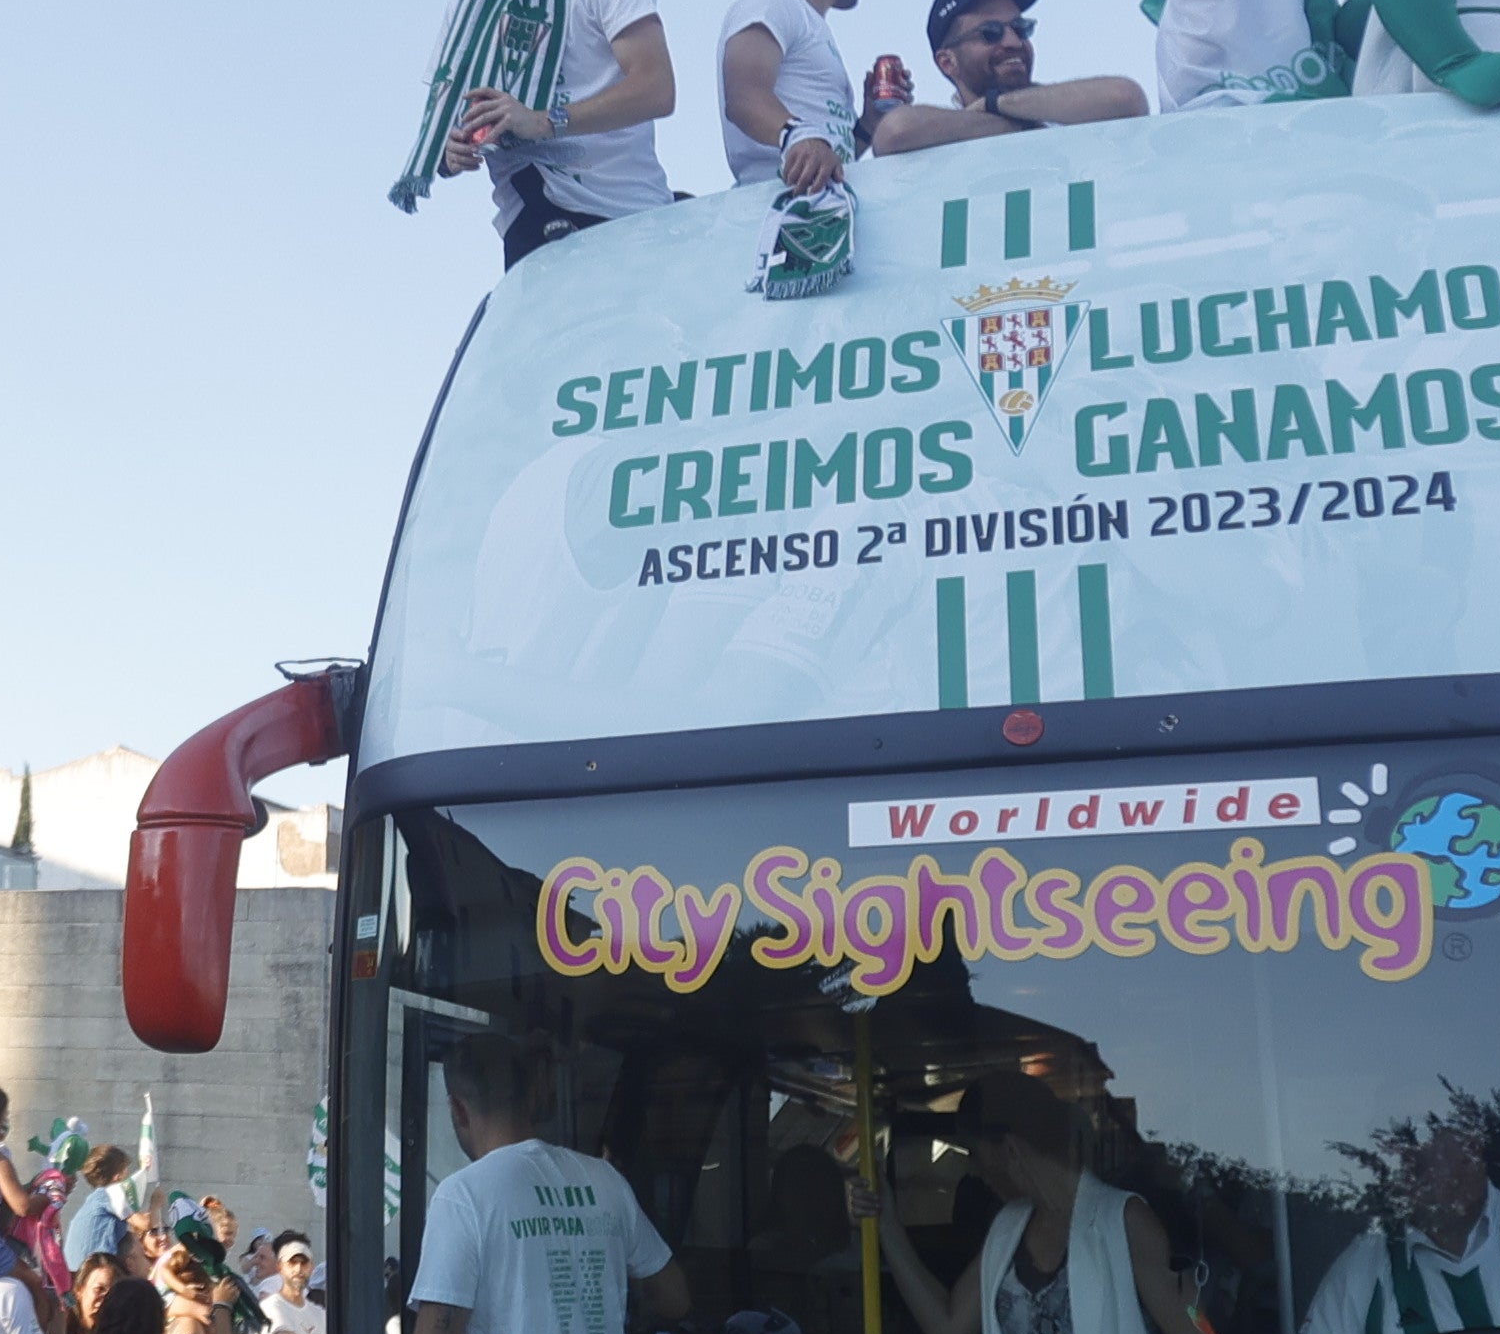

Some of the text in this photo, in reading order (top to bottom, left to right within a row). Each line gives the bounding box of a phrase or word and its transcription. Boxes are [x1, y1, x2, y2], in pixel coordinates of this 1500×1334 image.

[551, 330, 941, 437] SENTIMOS
[609, 420, 973, 528] CREIMOS
[637, 470, 1457, 587] ASCENSO 2ª DIVISIÓN 2023/2024
[887, 786, 1302, 839] Worldwide
[537, 856, 741, 993] City
[744, 837, 1433, 996] Sightseeing
[510, 1216, 551, 1240] VIVIR
